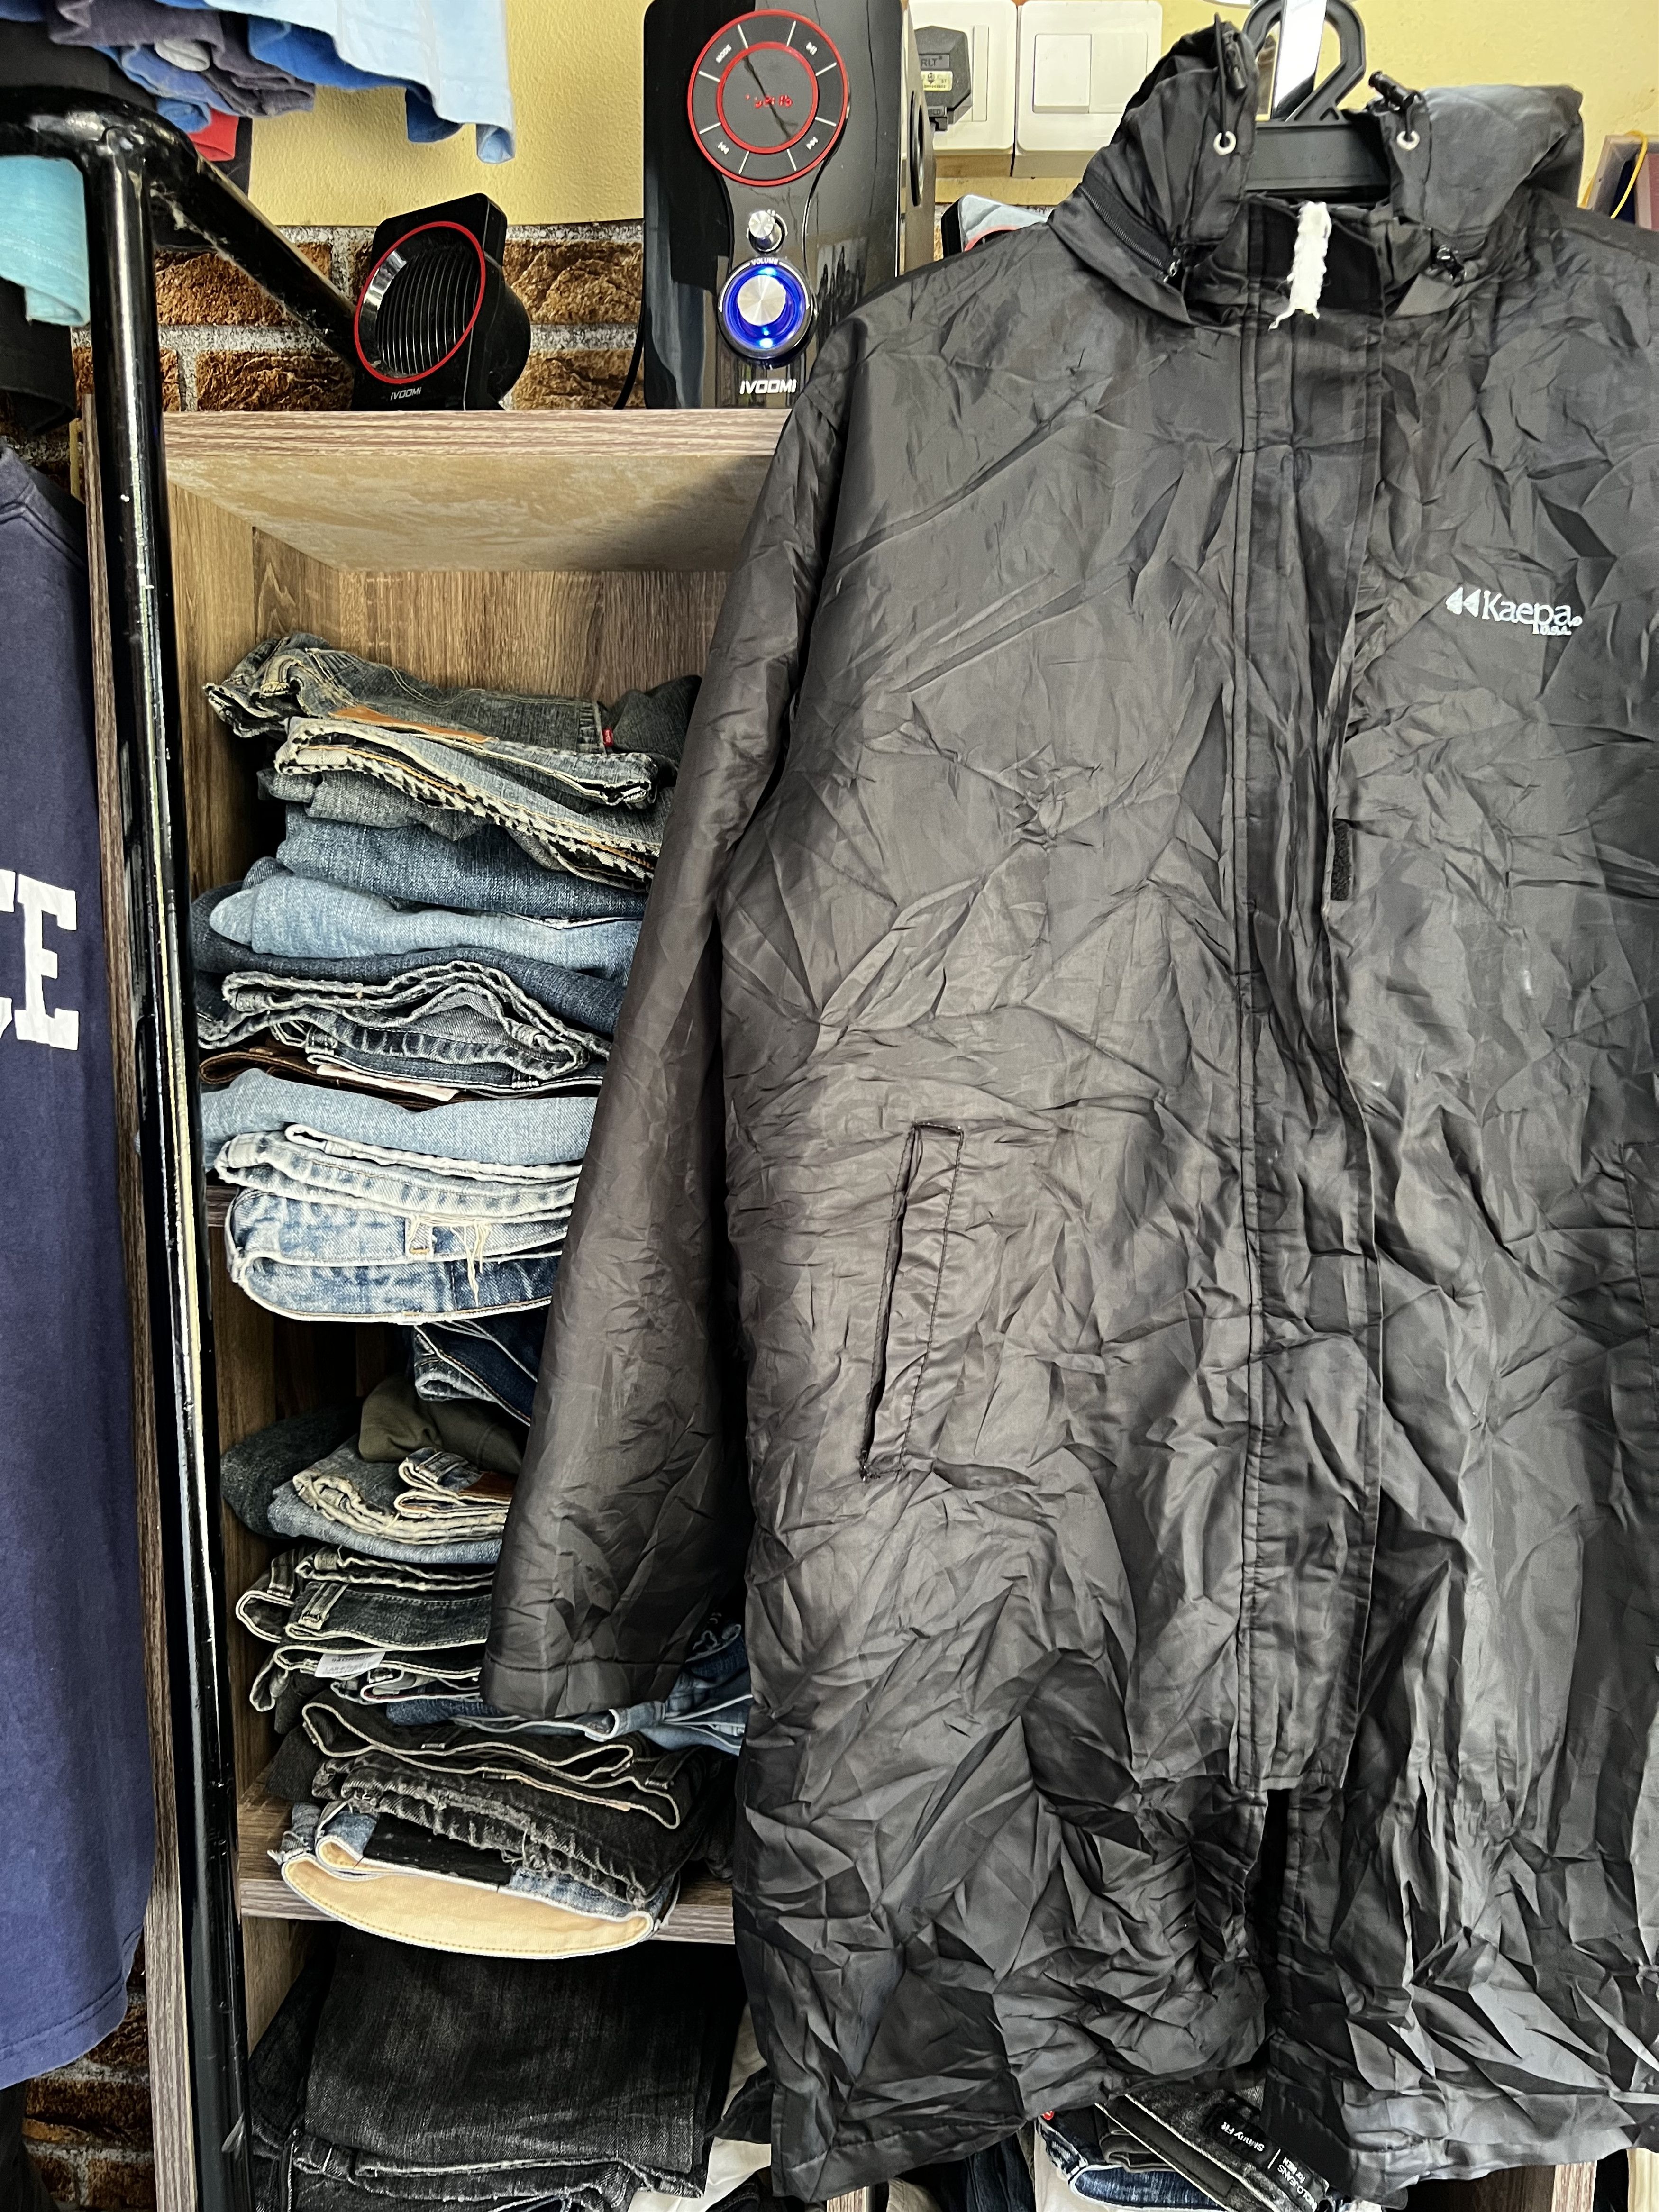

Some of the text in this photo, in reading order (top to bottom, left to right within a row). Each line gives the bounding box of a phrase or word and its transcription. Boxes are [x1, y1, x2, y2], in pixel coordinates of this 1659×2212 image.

[716, 44, 732, 63] MODE
[751, 257, 778, 265] VOLUME
[1482, 590, 1573, 635] Kaepa
[1221, 2121, 1265, 2151] Skinny Fit
